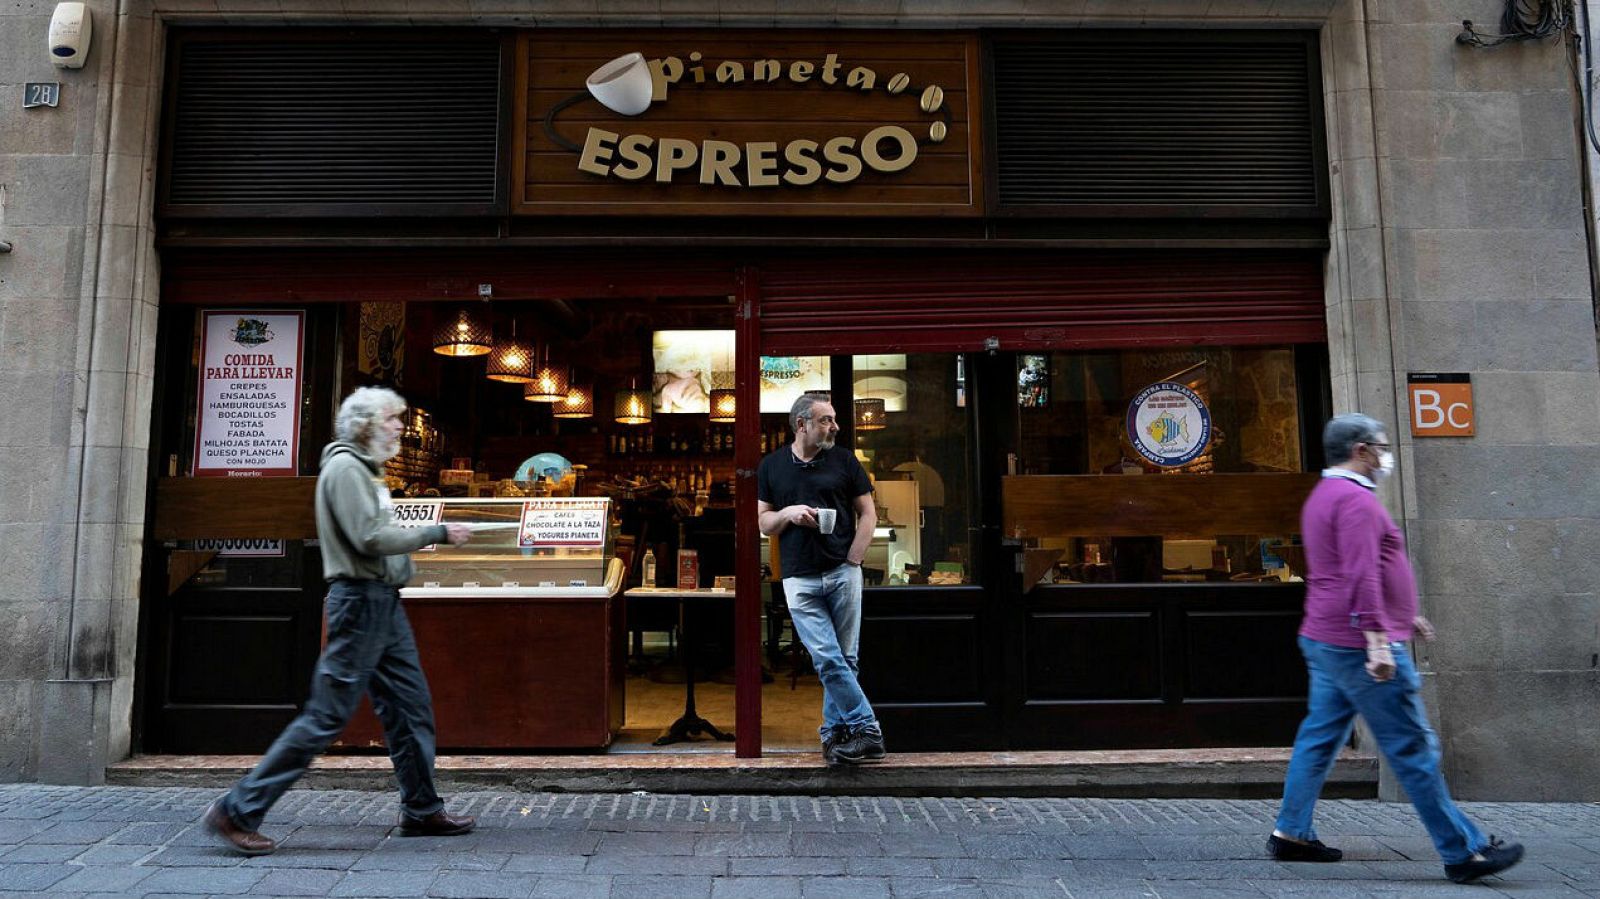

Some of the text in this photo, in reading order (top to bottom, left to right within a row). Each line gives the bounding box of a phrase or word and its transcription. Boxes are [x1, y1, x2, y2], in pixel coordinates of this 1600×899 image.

[647, 51, 877, 101] pianeta
[577, 125, 919, 187] ESPRESSO
[224, 354, 275, 366] COMIDA
[207, 367, 293, 379] PARA LLEVAR
[760, 369, 800, 379] ESPRESSO
[1134, 384, 1160, 405] CONTRA
[584, 520, 601, 528] TAZA
